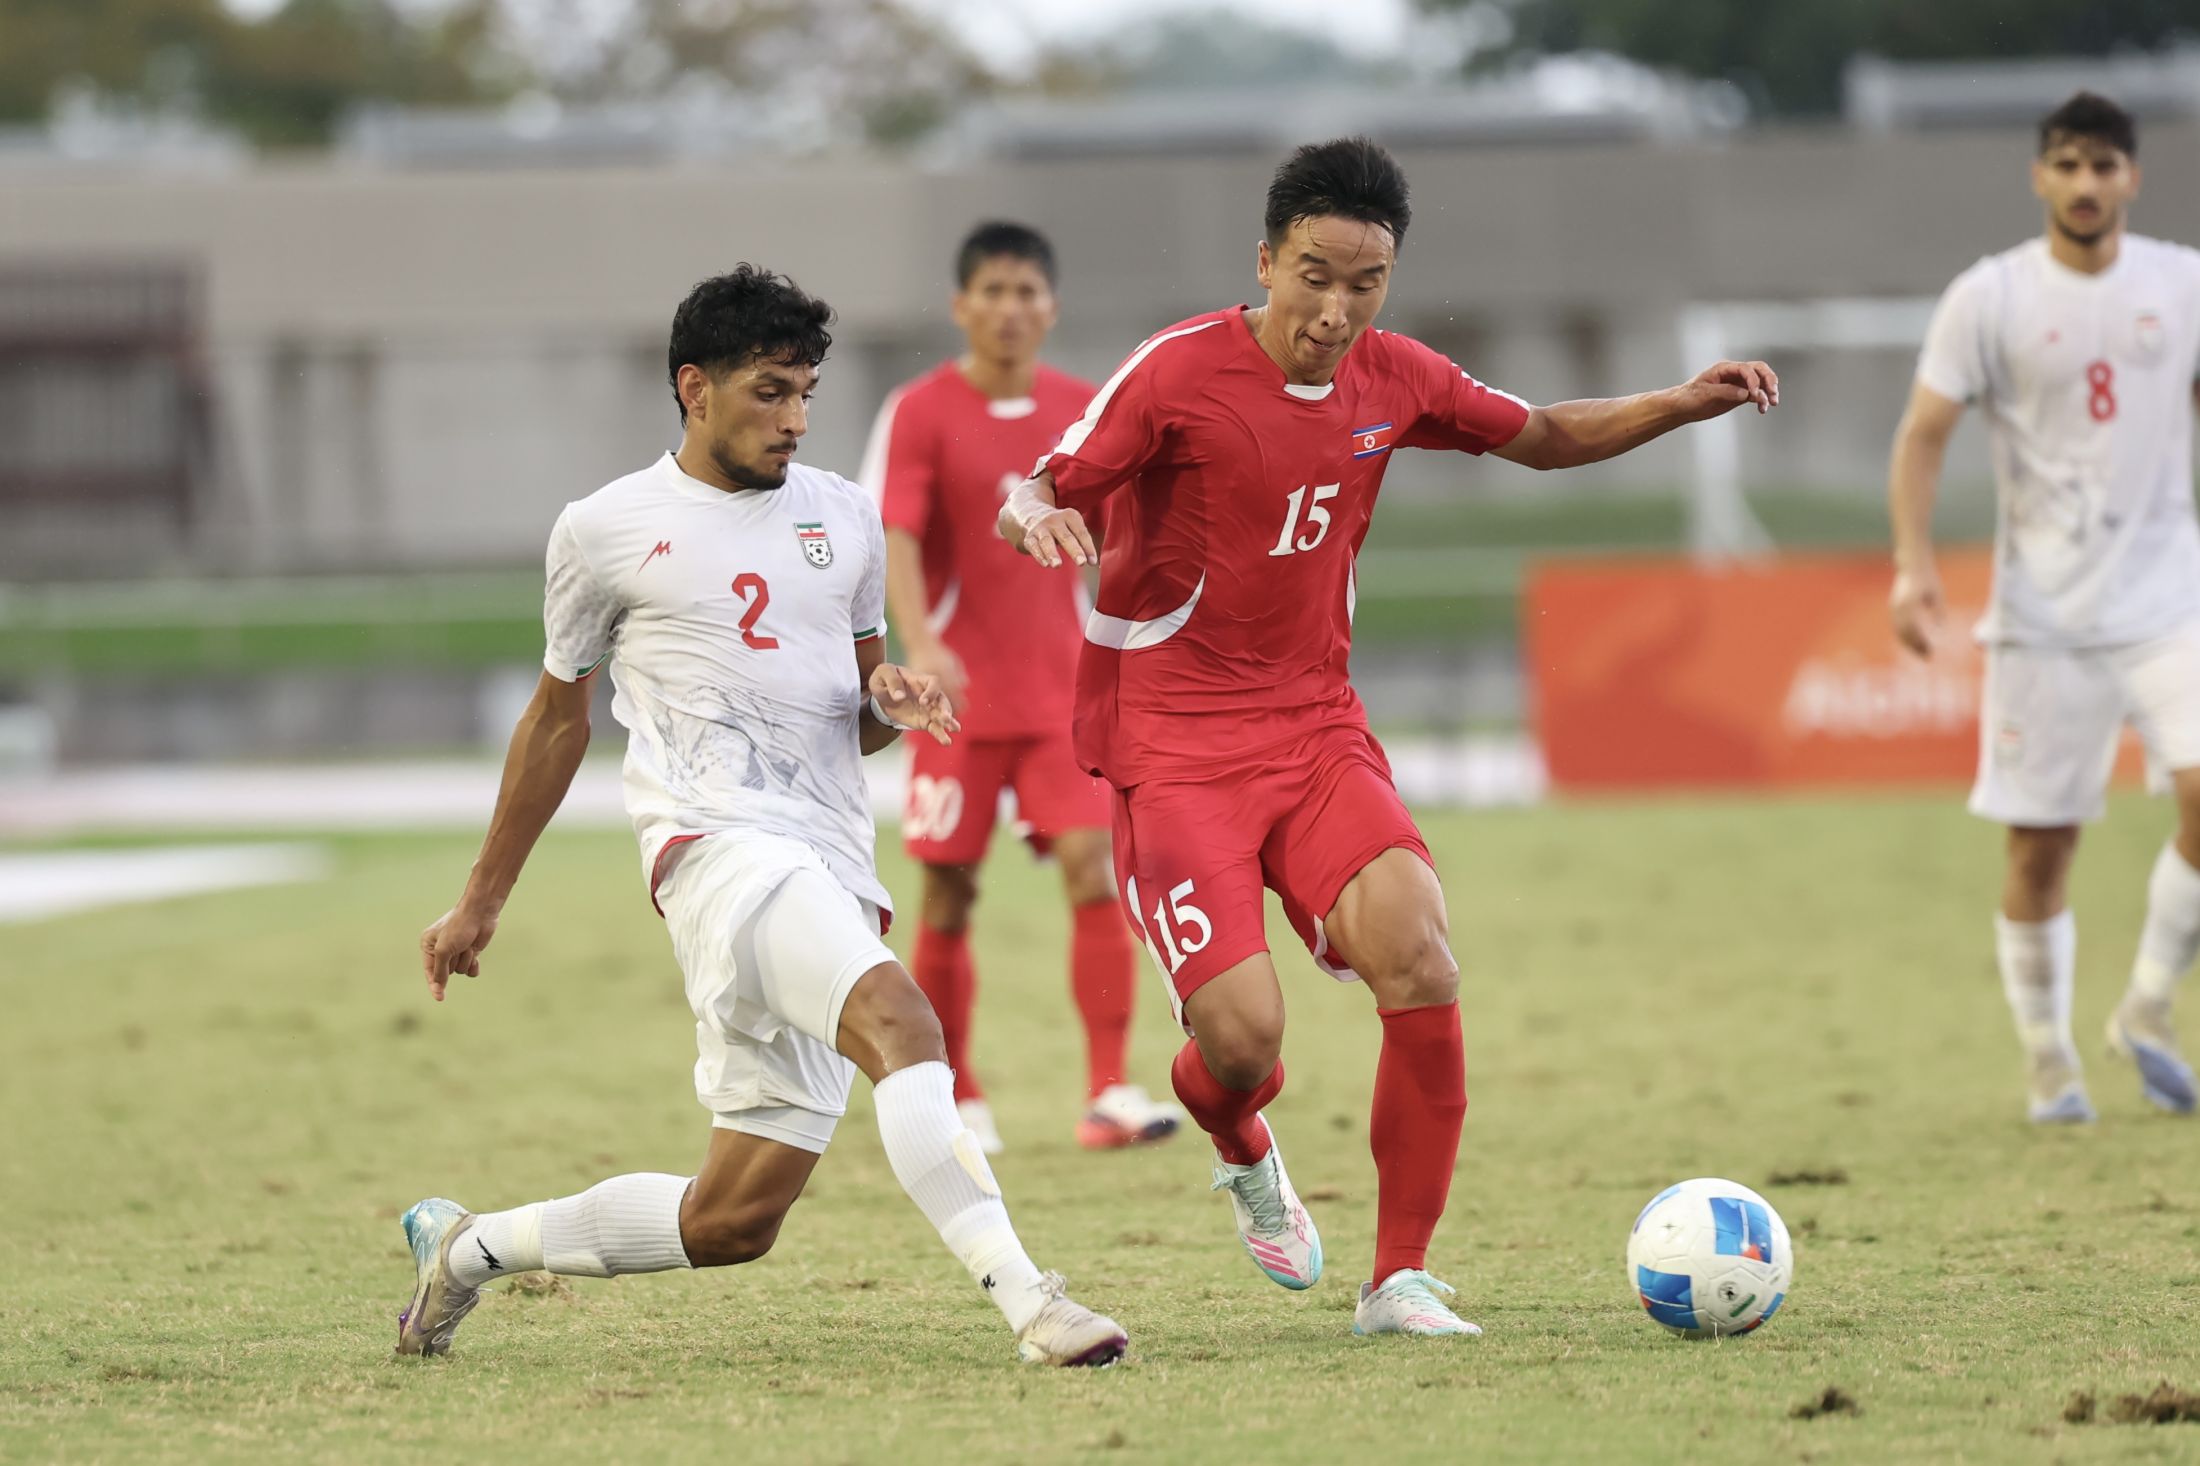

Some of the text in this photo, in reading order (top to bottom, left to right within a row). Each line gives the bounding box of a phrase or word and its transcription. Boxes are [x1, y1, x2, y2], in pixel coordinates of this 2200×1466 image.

[2086, 360, 2117, 423] 8
[1268, 482, 1341, 556] 15
[732, 572, 779, 650] 2
[1152, 878, 1213, 975] 15
